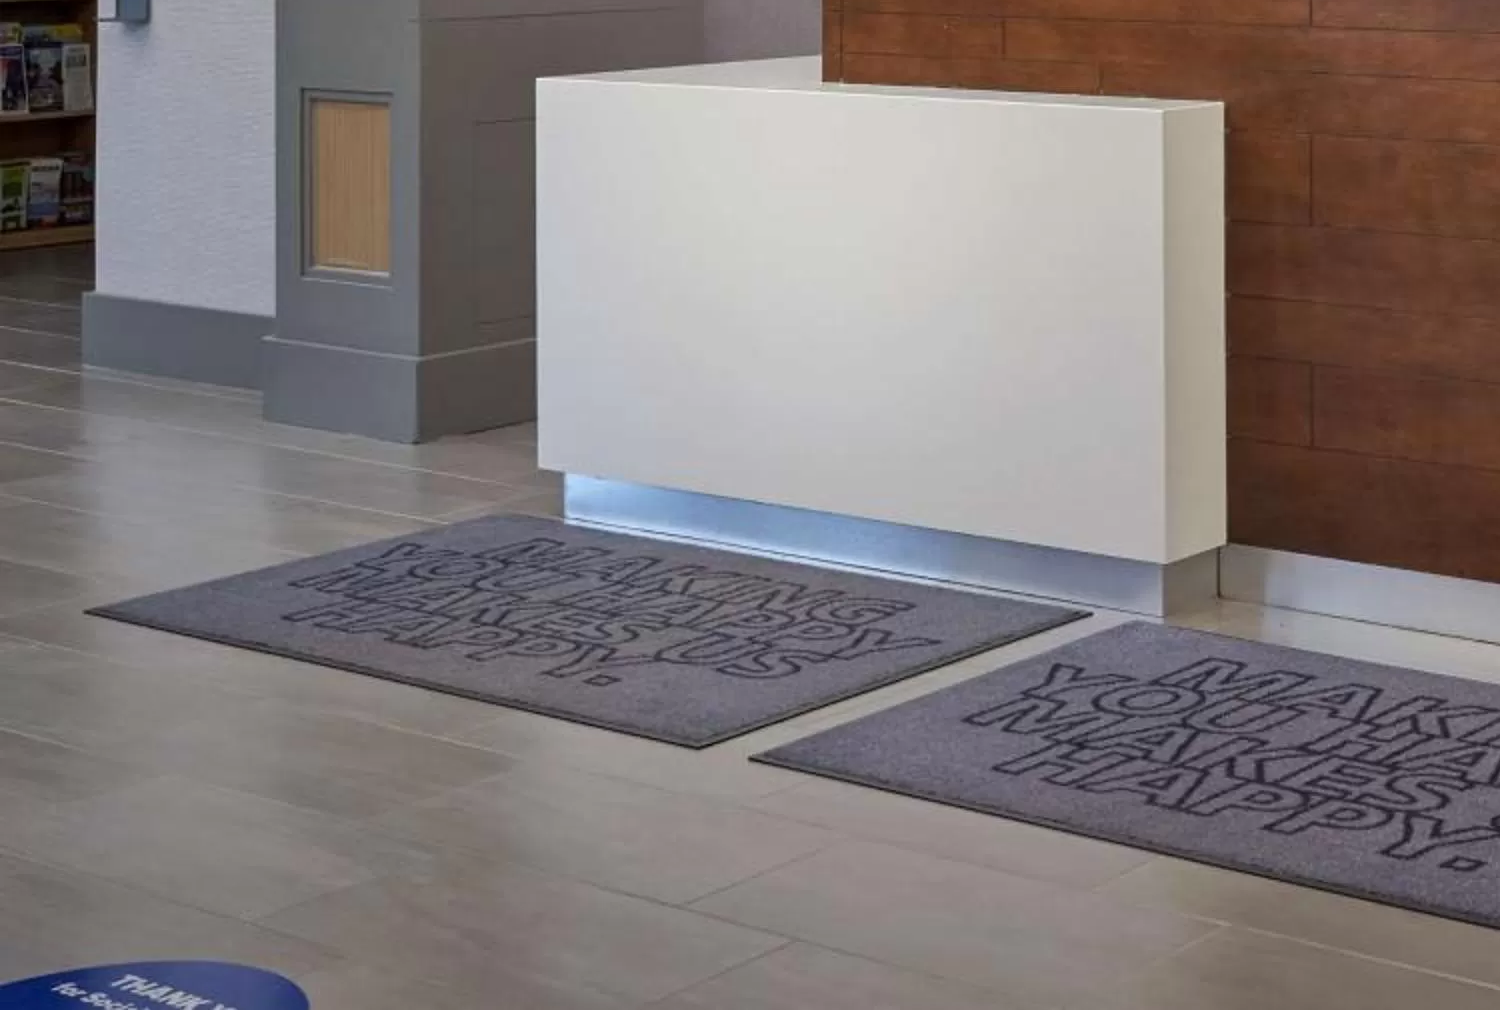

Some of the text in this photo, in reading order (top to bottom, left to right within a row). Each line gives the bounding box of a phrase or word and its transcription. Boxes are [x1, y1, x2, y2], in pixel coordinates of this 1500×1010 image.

[287, 564, 836, 679] MAKES US
[353, 541, 942, 661] YOU HAPPY
[470, 537, 917, 627] MAKING
[1021, 662, 1303, 734] YOU
[961, 696, 1474, 811] MAKES
[51, 982, 88, 997] for
[110, 974, 213, 1010] THANK
